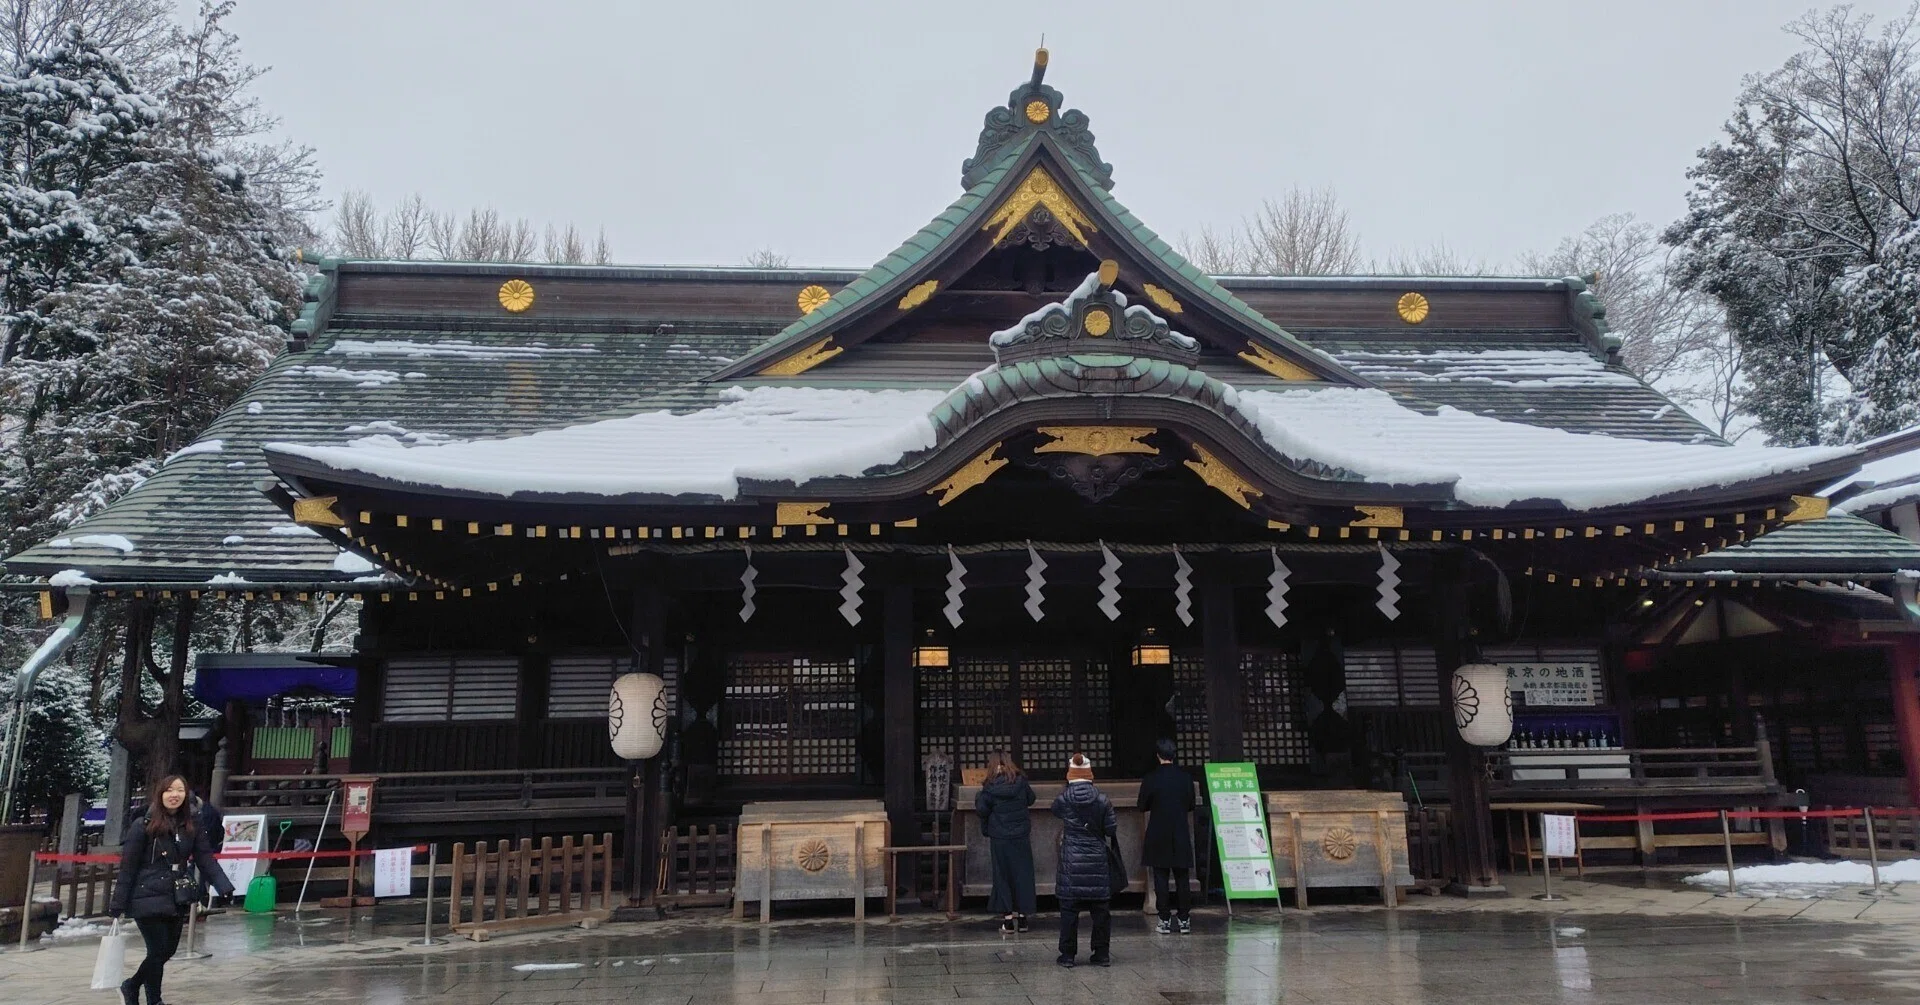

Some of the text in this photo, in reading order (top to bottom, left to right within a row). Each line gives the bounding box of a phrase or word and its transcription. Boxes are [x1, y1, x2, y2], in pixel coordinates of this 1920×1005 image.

[1506, 666, 1585, 678] 東京の地酒
[1212, 780, 1255, 789] 参拝作法
